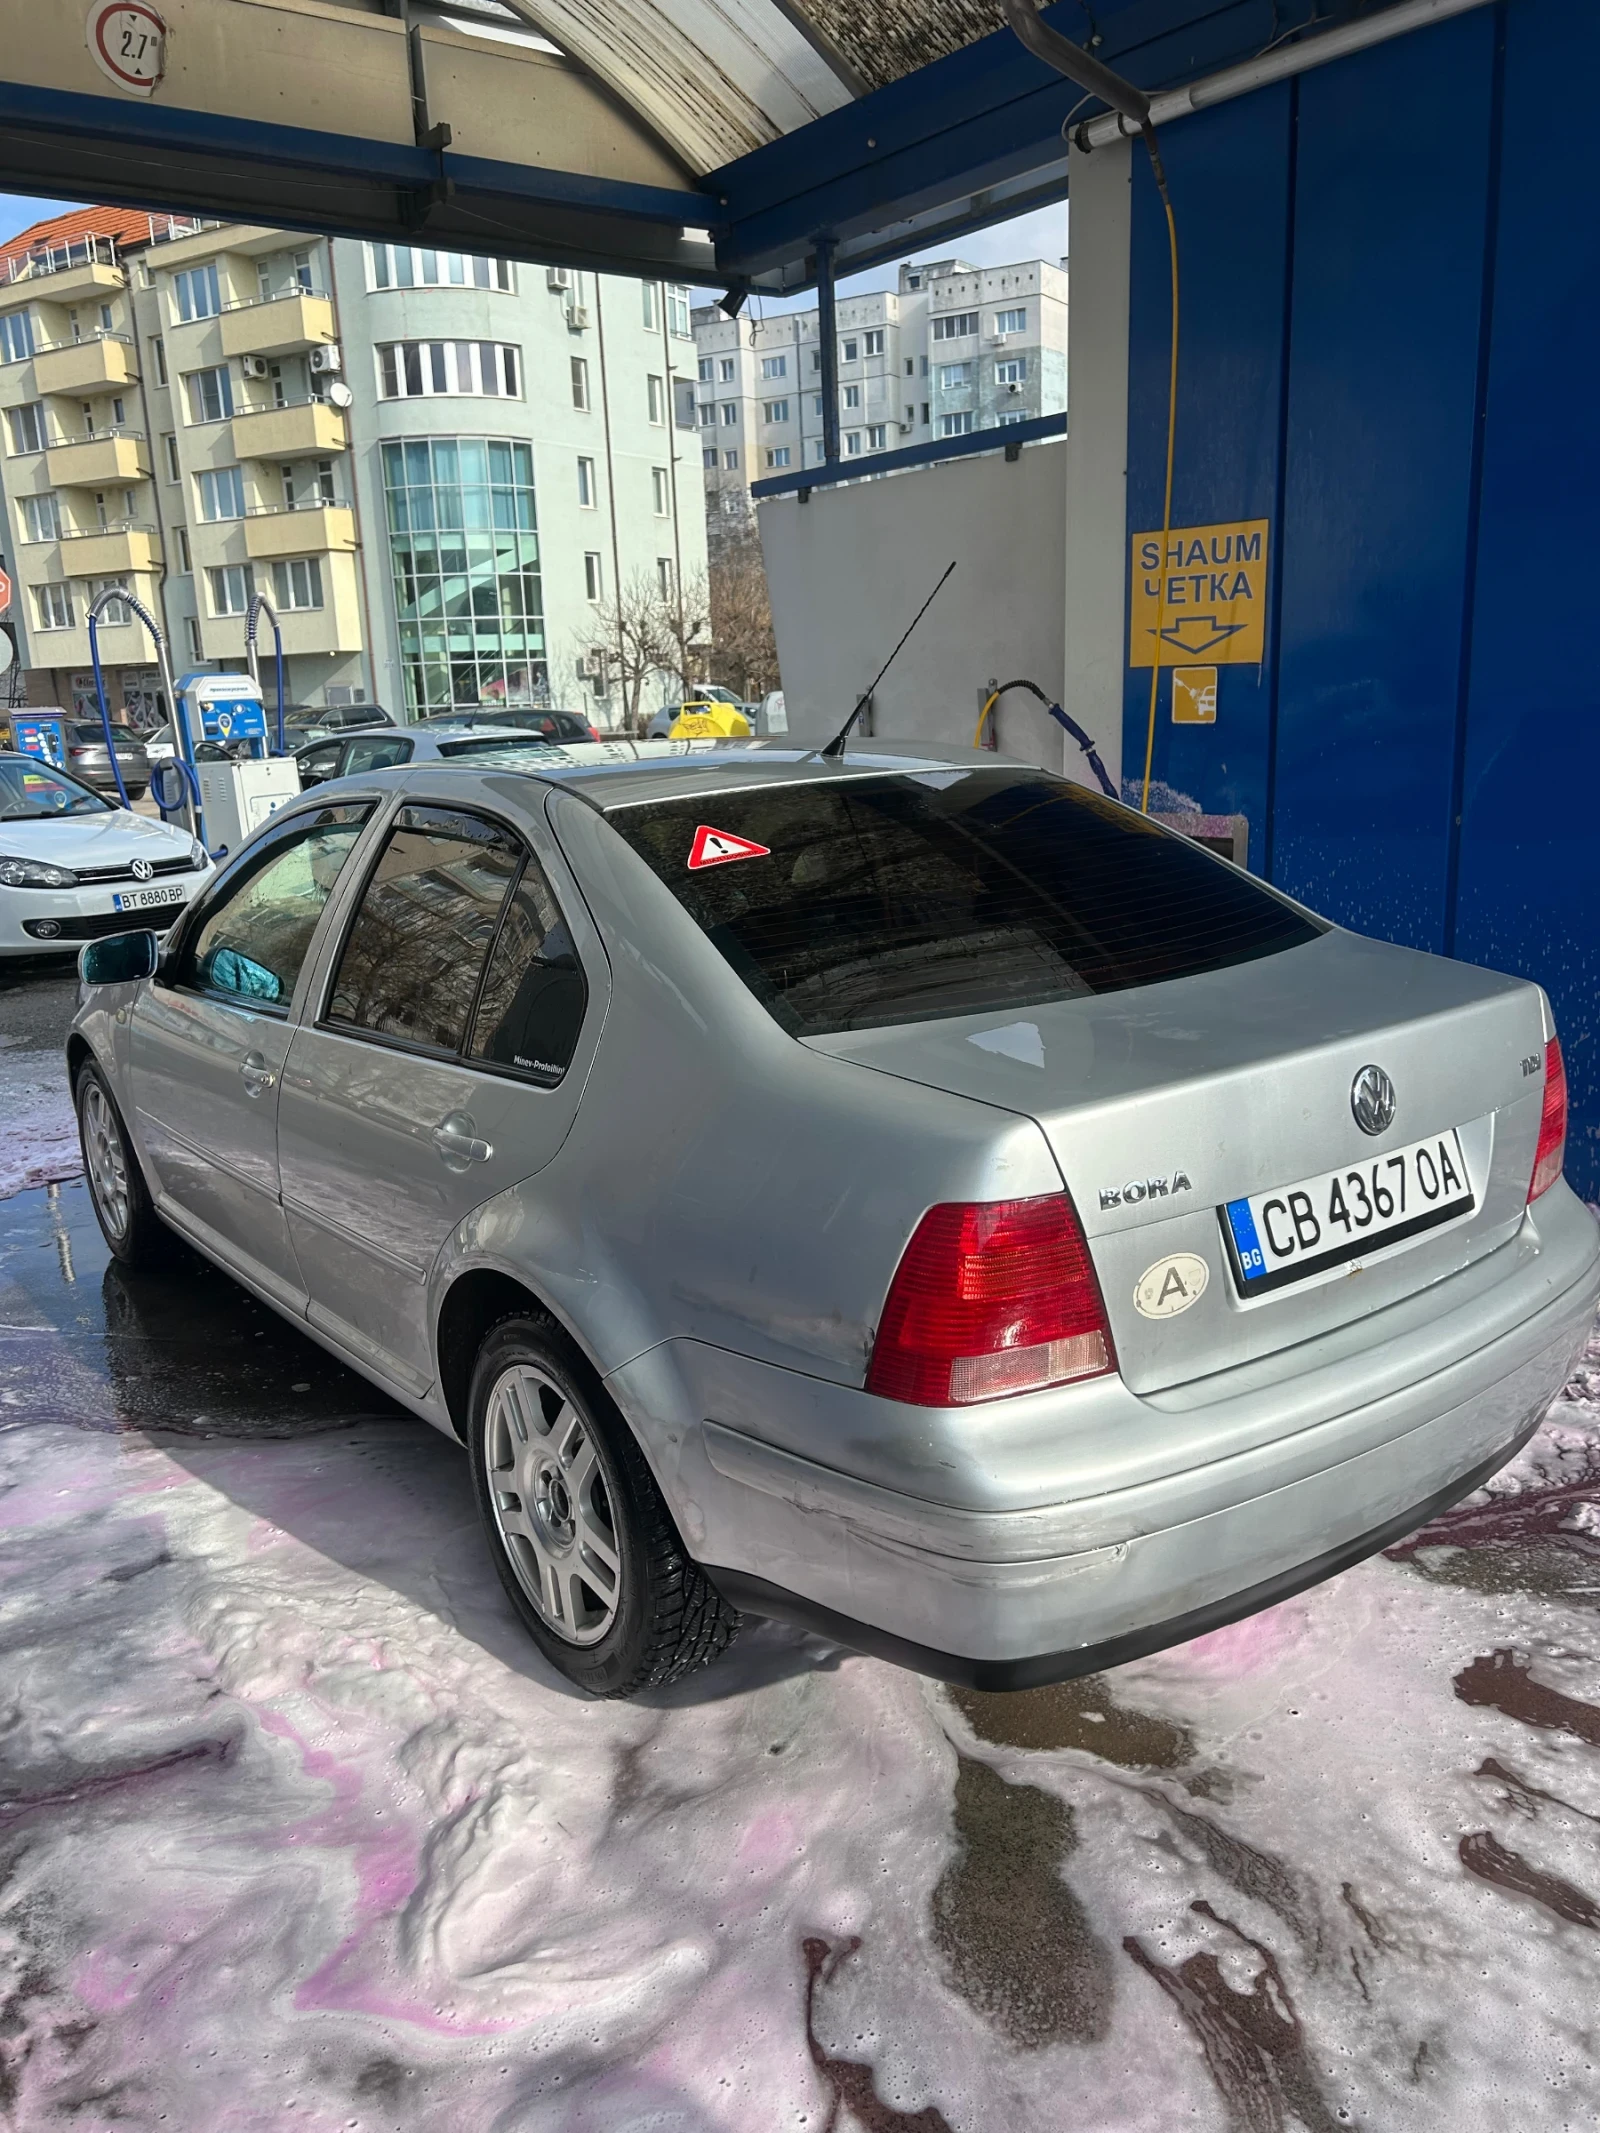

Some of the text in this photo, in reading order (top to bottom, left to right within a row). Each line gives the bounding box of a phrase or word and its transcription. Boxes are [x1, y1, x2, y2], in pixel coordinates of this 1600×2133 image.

[1141, 532, 1261, 570] SHAUM
[1144, 571, 1253, 604] ЧЕТКА
[121, 888, 183, 909] BT 8880 BP
[1098, 1170, 1193, 1211] BORA
[1262, 1141, 1462, 1258] CB 4367 OA
[1241, 1248, 1263, 1271] BG
[1157, 1266, 1189, 1307] A
